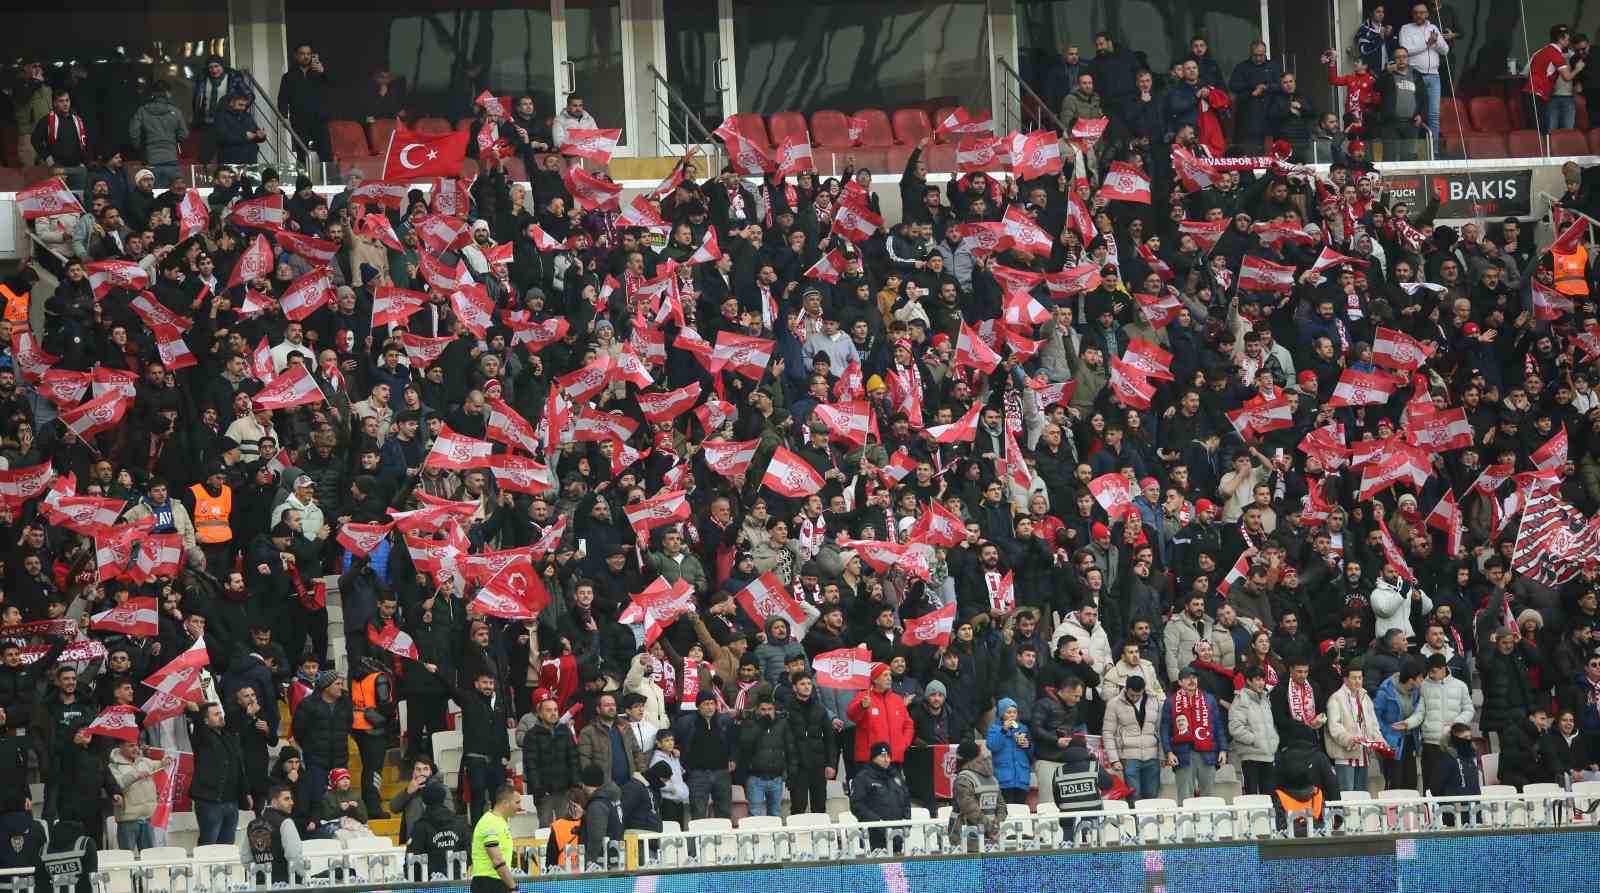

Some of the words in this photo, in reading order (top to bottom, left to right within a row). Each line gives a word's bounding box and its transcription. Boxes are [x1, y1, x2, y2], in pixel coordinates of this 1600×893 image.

[1450, 179, 1517, 200] BAKIŞ
[1062, 783, 1091, 795] POLIS
[48, 862, 77, 874] POLIS
